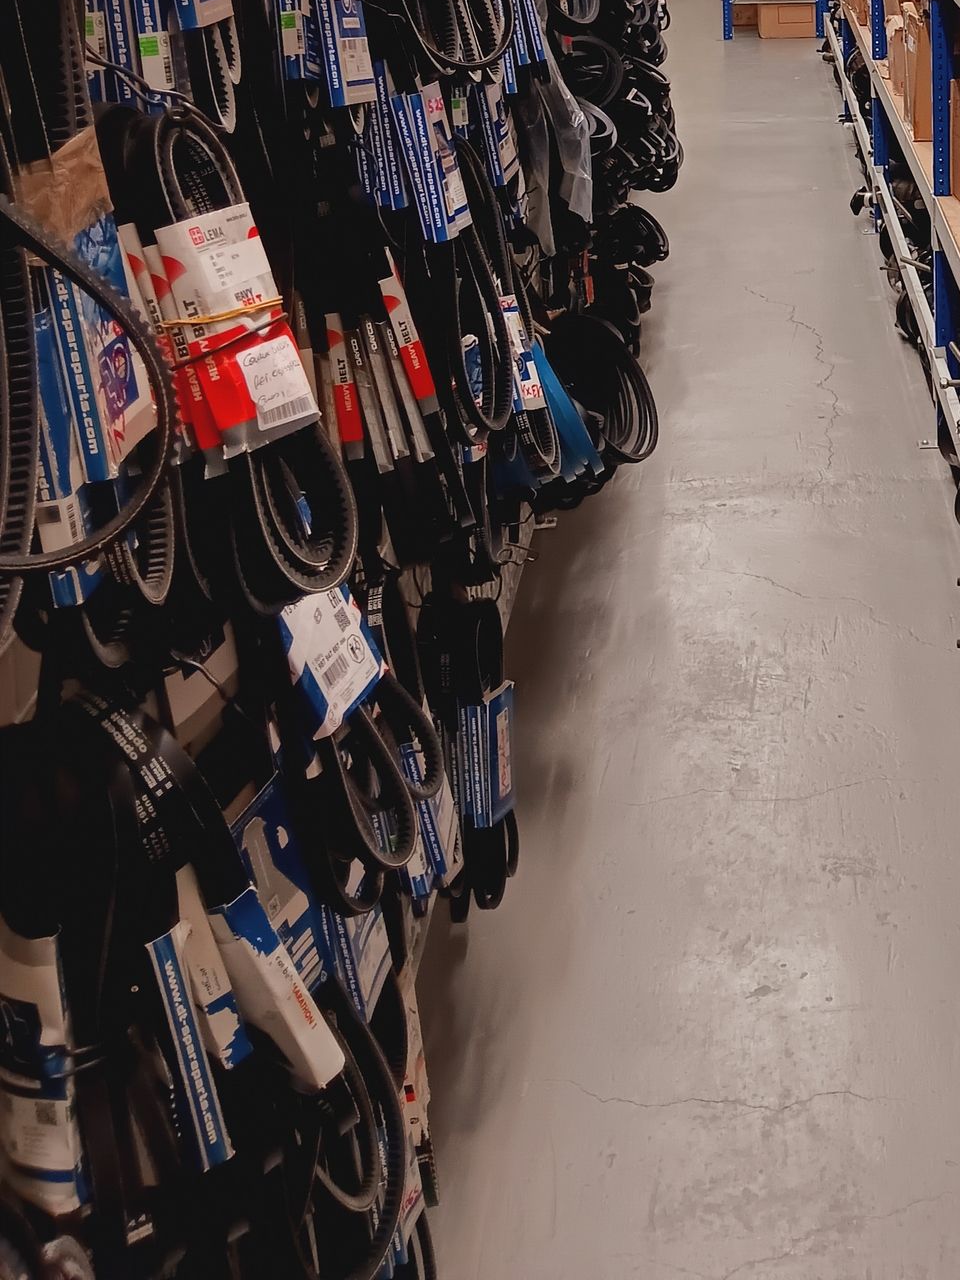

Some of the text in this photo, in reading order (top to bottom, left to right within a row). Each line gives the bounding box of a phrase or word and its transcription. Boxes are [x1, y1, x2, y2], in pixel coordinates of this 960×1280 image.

[415, 109, 442, 228] www.dt-spareparts.com
[206, 227, 224, 242] LEMA
[183, 299, 206, 338] BLT
[399, 320, 413, 345] BELT
[169, 326, 190, 359] BEL
[351, 338, 363, 367] DAYCO
[408, 343, 421, 370] HEAVY
[335, 358, 347, 384] BELT
[164, 959, 218, 1145] www.dt-spareparts.com
